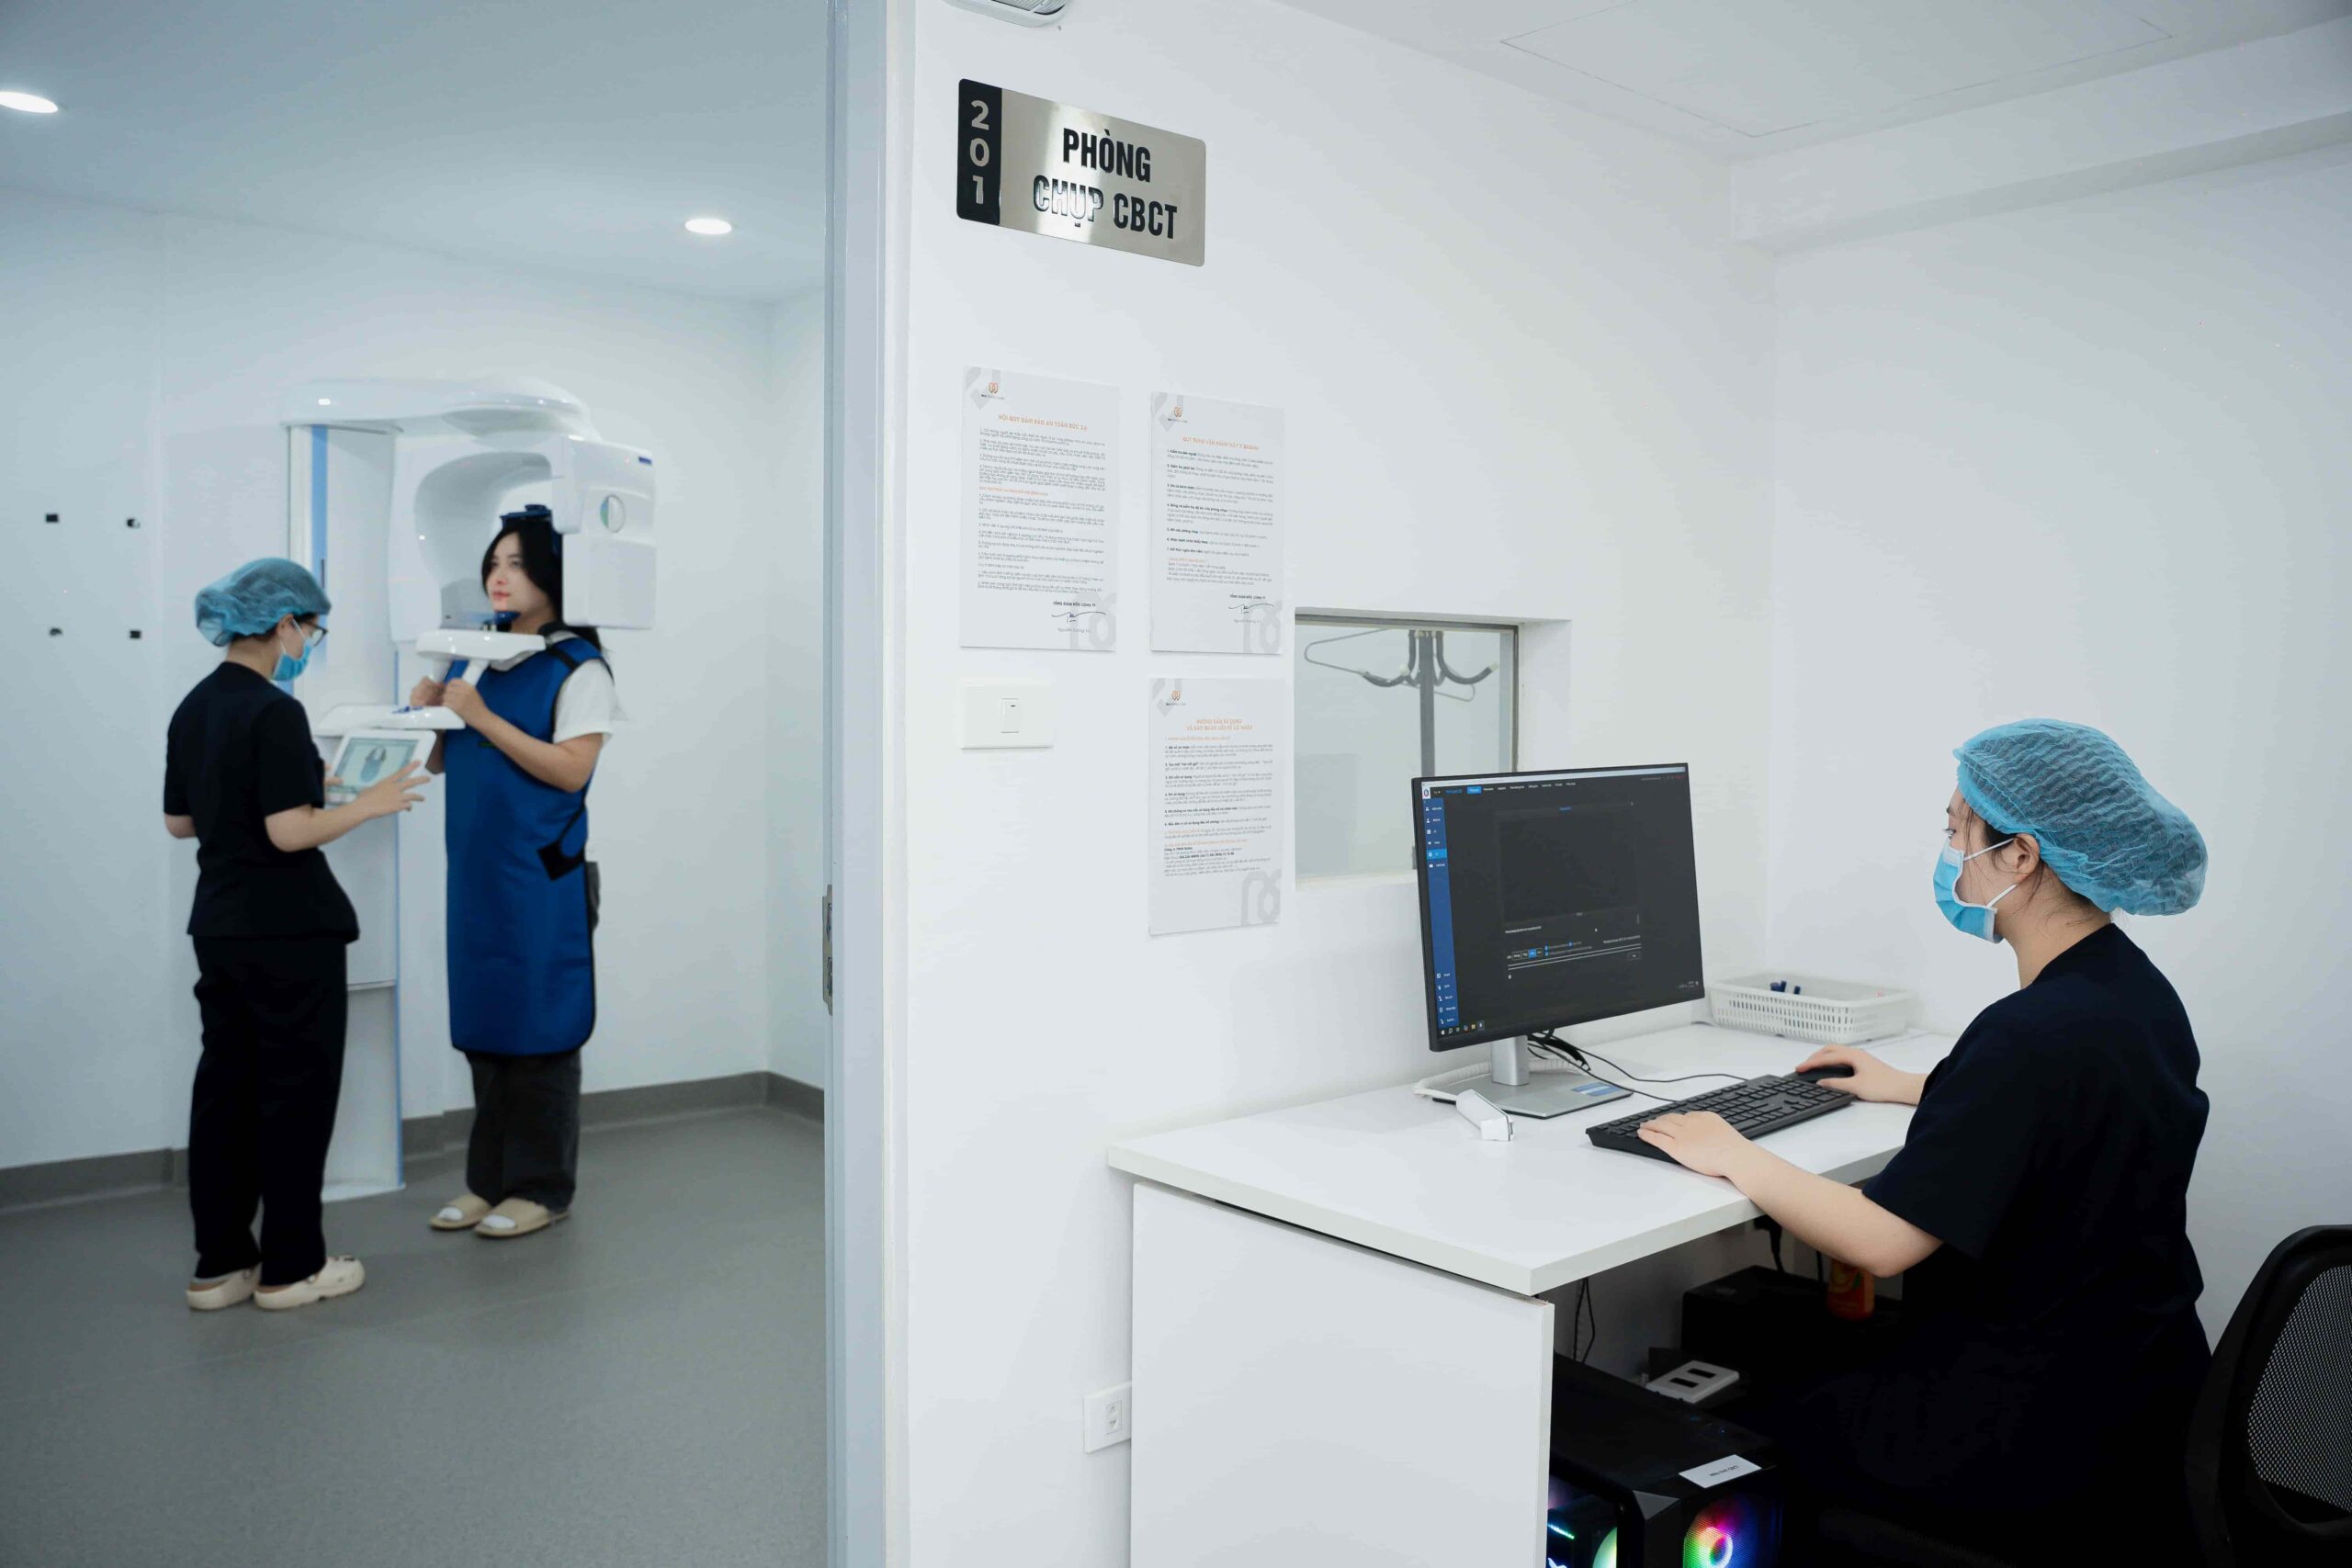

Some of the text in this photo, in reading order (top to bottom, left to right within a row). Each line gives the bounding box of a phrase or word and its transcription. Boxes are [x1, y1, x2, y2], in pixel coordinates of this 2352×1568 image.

[969, 99, 989, 205] 201
[1063, 128, 1151, 183] PHÒNG
[1033, 175, 1178, 239] CHỤP CBCT
